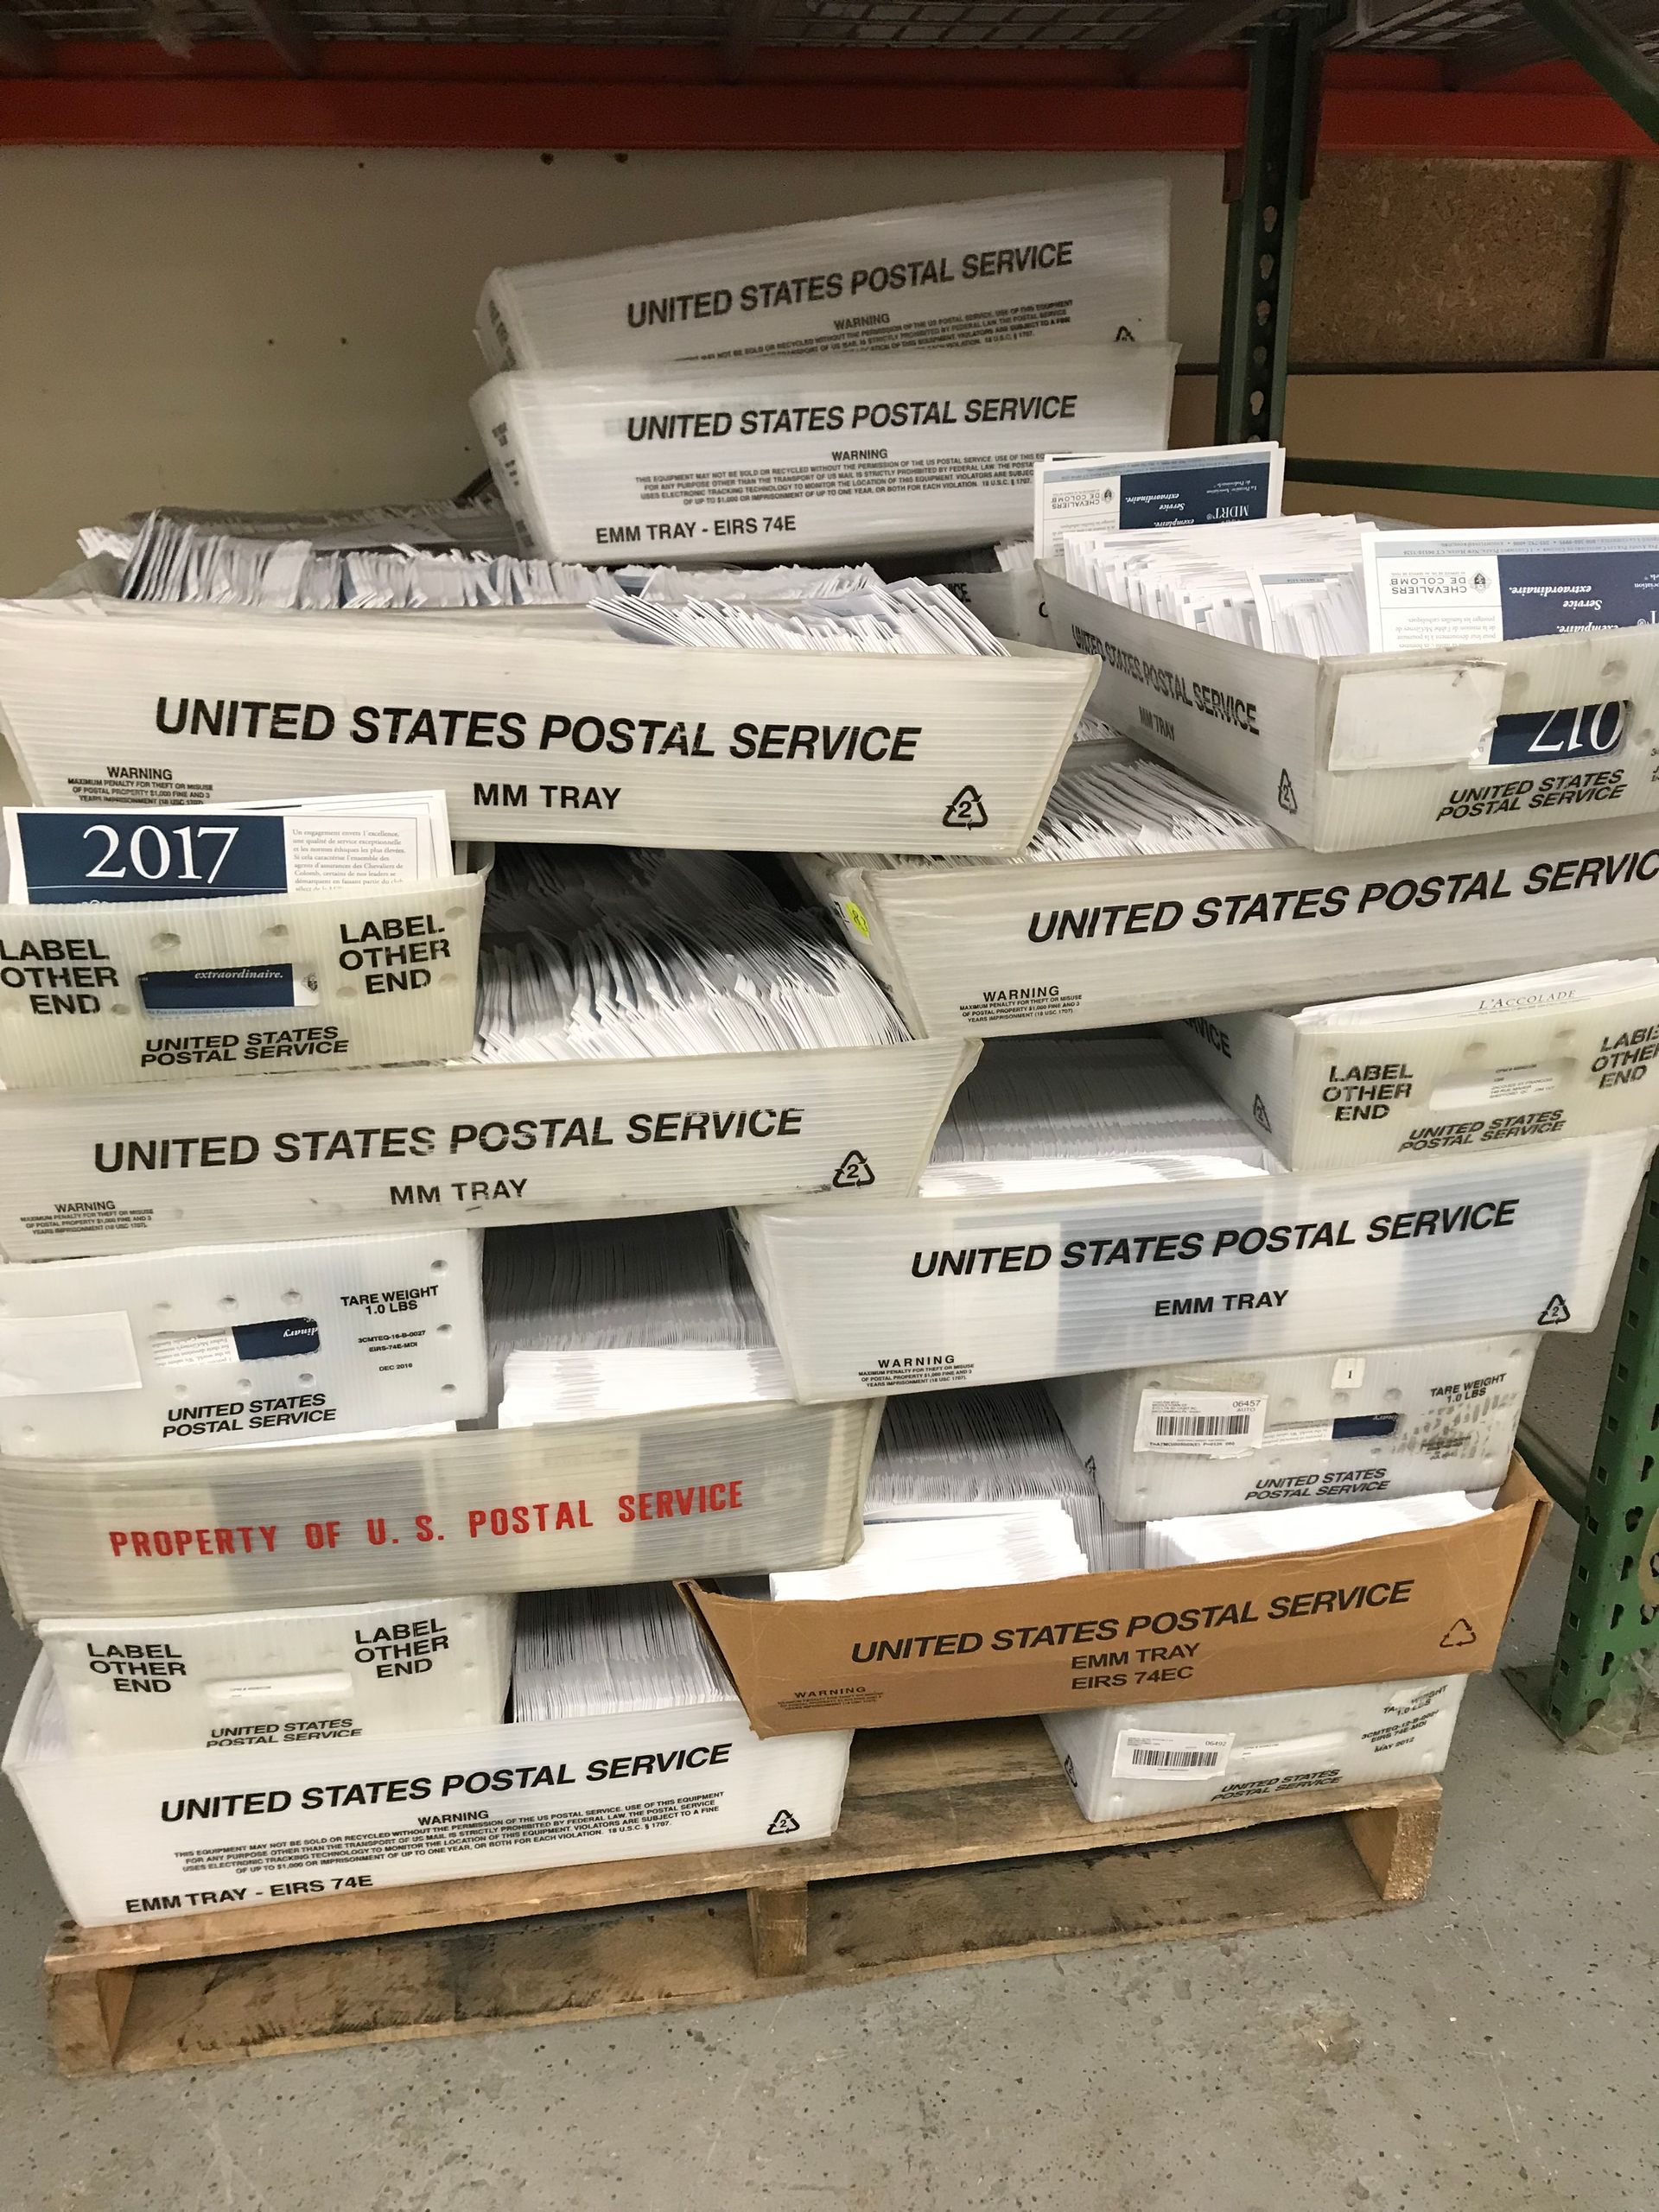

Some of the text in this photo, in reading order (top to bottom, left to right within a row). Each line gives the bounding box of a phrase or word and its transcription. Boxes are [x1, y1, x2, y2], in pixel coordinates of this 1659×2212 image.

[627, 240, 1072, 327] UNITED STATES POSTAL SERVICE
[833, 313, 890, 330] WARNING
[627, 394, 1077, 441] UNITED STATES POSTAL SERVICE
[831, 448, 887, 461] WARNING
[1052, 499, 1101, 510] CHEVALIERS
[1125, 493, 1180, 503] extraordinaire.
[1160, 502, 1185, 512] Service
[596, 515, 796, 543] EMM TRAY EIRS 74E
[1390, 576, 1466, 587] DE COLOMB
[1391, 586, 1467, 595] CHEVALIERS
[1509, 584, 1592, 595] extraordinaire.
[1562, 599, 1603, 611] Service
[1071, 624, 1260, 735] UNITED STATES POSTAL SERVICE
[156, 696, 922, 761] UNITED STATES POSTAL SERVICE
[1139, 705, 1175, 741] MM TRAY
[1528, 700, 1625, 752] 017
[106, 766, 172, 780] WARNING
[474, 782, 621, 810] MM TRAY
[1449, 769, 1624, 804] UNITED STATES
[1435, 784, 1627, 821] POSTAL SERVICE
[82, 824, 239, 885] 2017
[1027, 849, 1659, 943] UNITED STATES POSTAL SERVIC
[340, 914, 445, 944] LABEL
[0, 939, 110, 961] LABEL
[338, 939, 451, 970] OTHER
[1, 966, 119, 988] OTHER
[194, 968, 283, 980] extraordinaire.
[365, 969, 432, 995] END
[29, 994, 101, 1015] END
[982, 985, 1058, 1001] WARNING
[146, 1026, 338, 1052] UNITED STATES
[1600, 1023, 1659, 1052] LABE
[141, 1039, 349, 1067] POSTAL SERVICE
[1328, 1064, 1414, 1083] LABEL
[1598, 1065, 1648, 1089] END
[1322, 1083, 1412, 1103] OTHER
[1334, 1103, 1390, 1122] END
[1397, 1120, 1566, 1152] POSTAL SERVICE
[1408, 1109, 1563, 1140] UNITED STATES
[94, 1108, 804, 1173] UNITED STATES POSTAL SERVICE
[390, 1178, 527, 1205] MM TRAY
[54, 1200, 115, 1212] WARNING
[911, 1198, 1519, 1278] UNITED STATES POSTAL SERVICE
[340, 1285, 438, 1306] TARE WEIGHT
[365, 1300, 417, 1314] 1.0 LBS
[1154, 1289, 1288, 1316] EMM TRAY
[369, 1342, 417, 1352] EIRS-74E-MDI
[878, 1355, 954, 1368] WARNING
[1430, 1373, 1506, 1396] TARE WEIGHT
[1447, 1387, 1486, 1403] 1.0 LBS
[168, 1393, 325, 1421] UNITED STATES
[1232, 1400, 1261, 1408] 06457
[162, 1408, 336, 1438] POSTAL SERVICE
[1244, 1480, 1390, 1500] POSTAL SERVICE
[1255, 1468, 1387, 1489] UNITED STATES
[109, 1480, 744, 1557] PROPERTY OF U. S. POSTAL SERVICE
[354, 1618, 447, 1645] LABEL
[851, 1580, 1414, 1662] UNITED STATES POSTAL SERVICE
[87, 1643, 182, 1659] LABEL
[354, 1634, 449, 1664] OTHER
[1071, 1643, 1199, 1669] EMM TRAY
[89, 1660, 187, 1677] OTHER
[376, 1657, 433, 1679] END
[1071, 1666, 1193, 1689] EIRS 74EC
[113, 1678, 172, 1694] END
[794, 1687, 865, 1698] WARNING
[207, 1728, 363, 1749] POSTAL SERVICE
[211, 1719, 352, 1738] UNITED STATES
[1374, 1737, 1414, 1752] MAY 2012
[161, 1743, 732, 1821] UNITED STATES POSTAL SERVICE
[1210, 1776, 1342, 1802] POSTAL SERVICE
[1221, 1769, 1340, 1792] UNITED STATES
[417, 1810, 488, 1826] WARNING
[125, 1875, 373, 1913] EMM TRAY EIRS 74E
